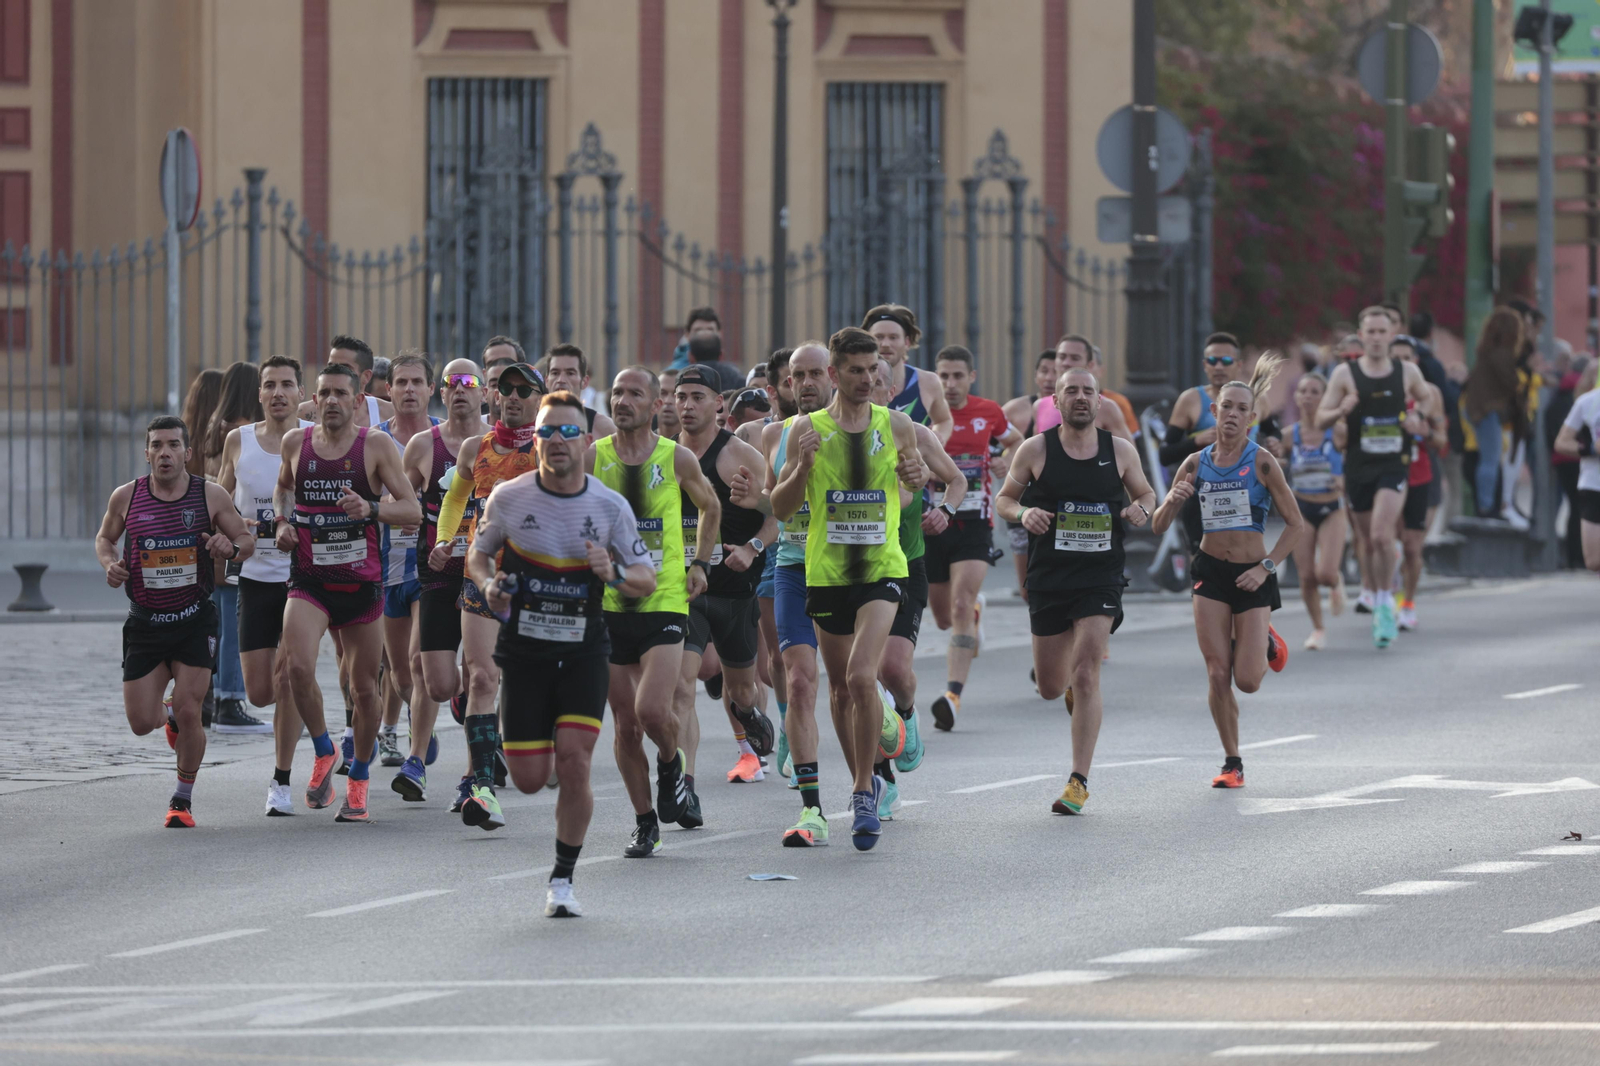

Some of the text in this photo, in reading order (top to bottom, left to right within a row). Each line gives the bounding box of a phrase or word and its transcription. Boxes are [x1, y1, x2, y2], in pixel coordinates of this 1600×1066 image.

[303, 479, 353, 489] OCTAVUS
[1212, 481, 1242, 490] ZURICH
[303, 488, 347, 501] TRIATLÓ
[846, 493, 880, 501] ZURICH
[1214, 497, 1231, 506] F229
[846, 510, 868, 519] 1576
[1212, 509, 1237, 517] ADRIANA
[326, 516, 357, 524] ZURIC
[636, 520, 656, 529] RICH
[800, 520, 810, 528] 14
[1076, 520, 1094, 529] 1261
[328, 531, 348, 541] 2989
[158, 538, 190, 548] ZURICH
[326, 543, 352, 552] URBANO
[158, 556, 178, 564] 3861
[156, 567, 184, 576] PAULINO
[542, 582, 580, 595] ZURICH
[180, 602, 200, 620] MAX
[540, 601, 564, 612] 2591
[528, 614, 576, 626] PEPE VALERO
